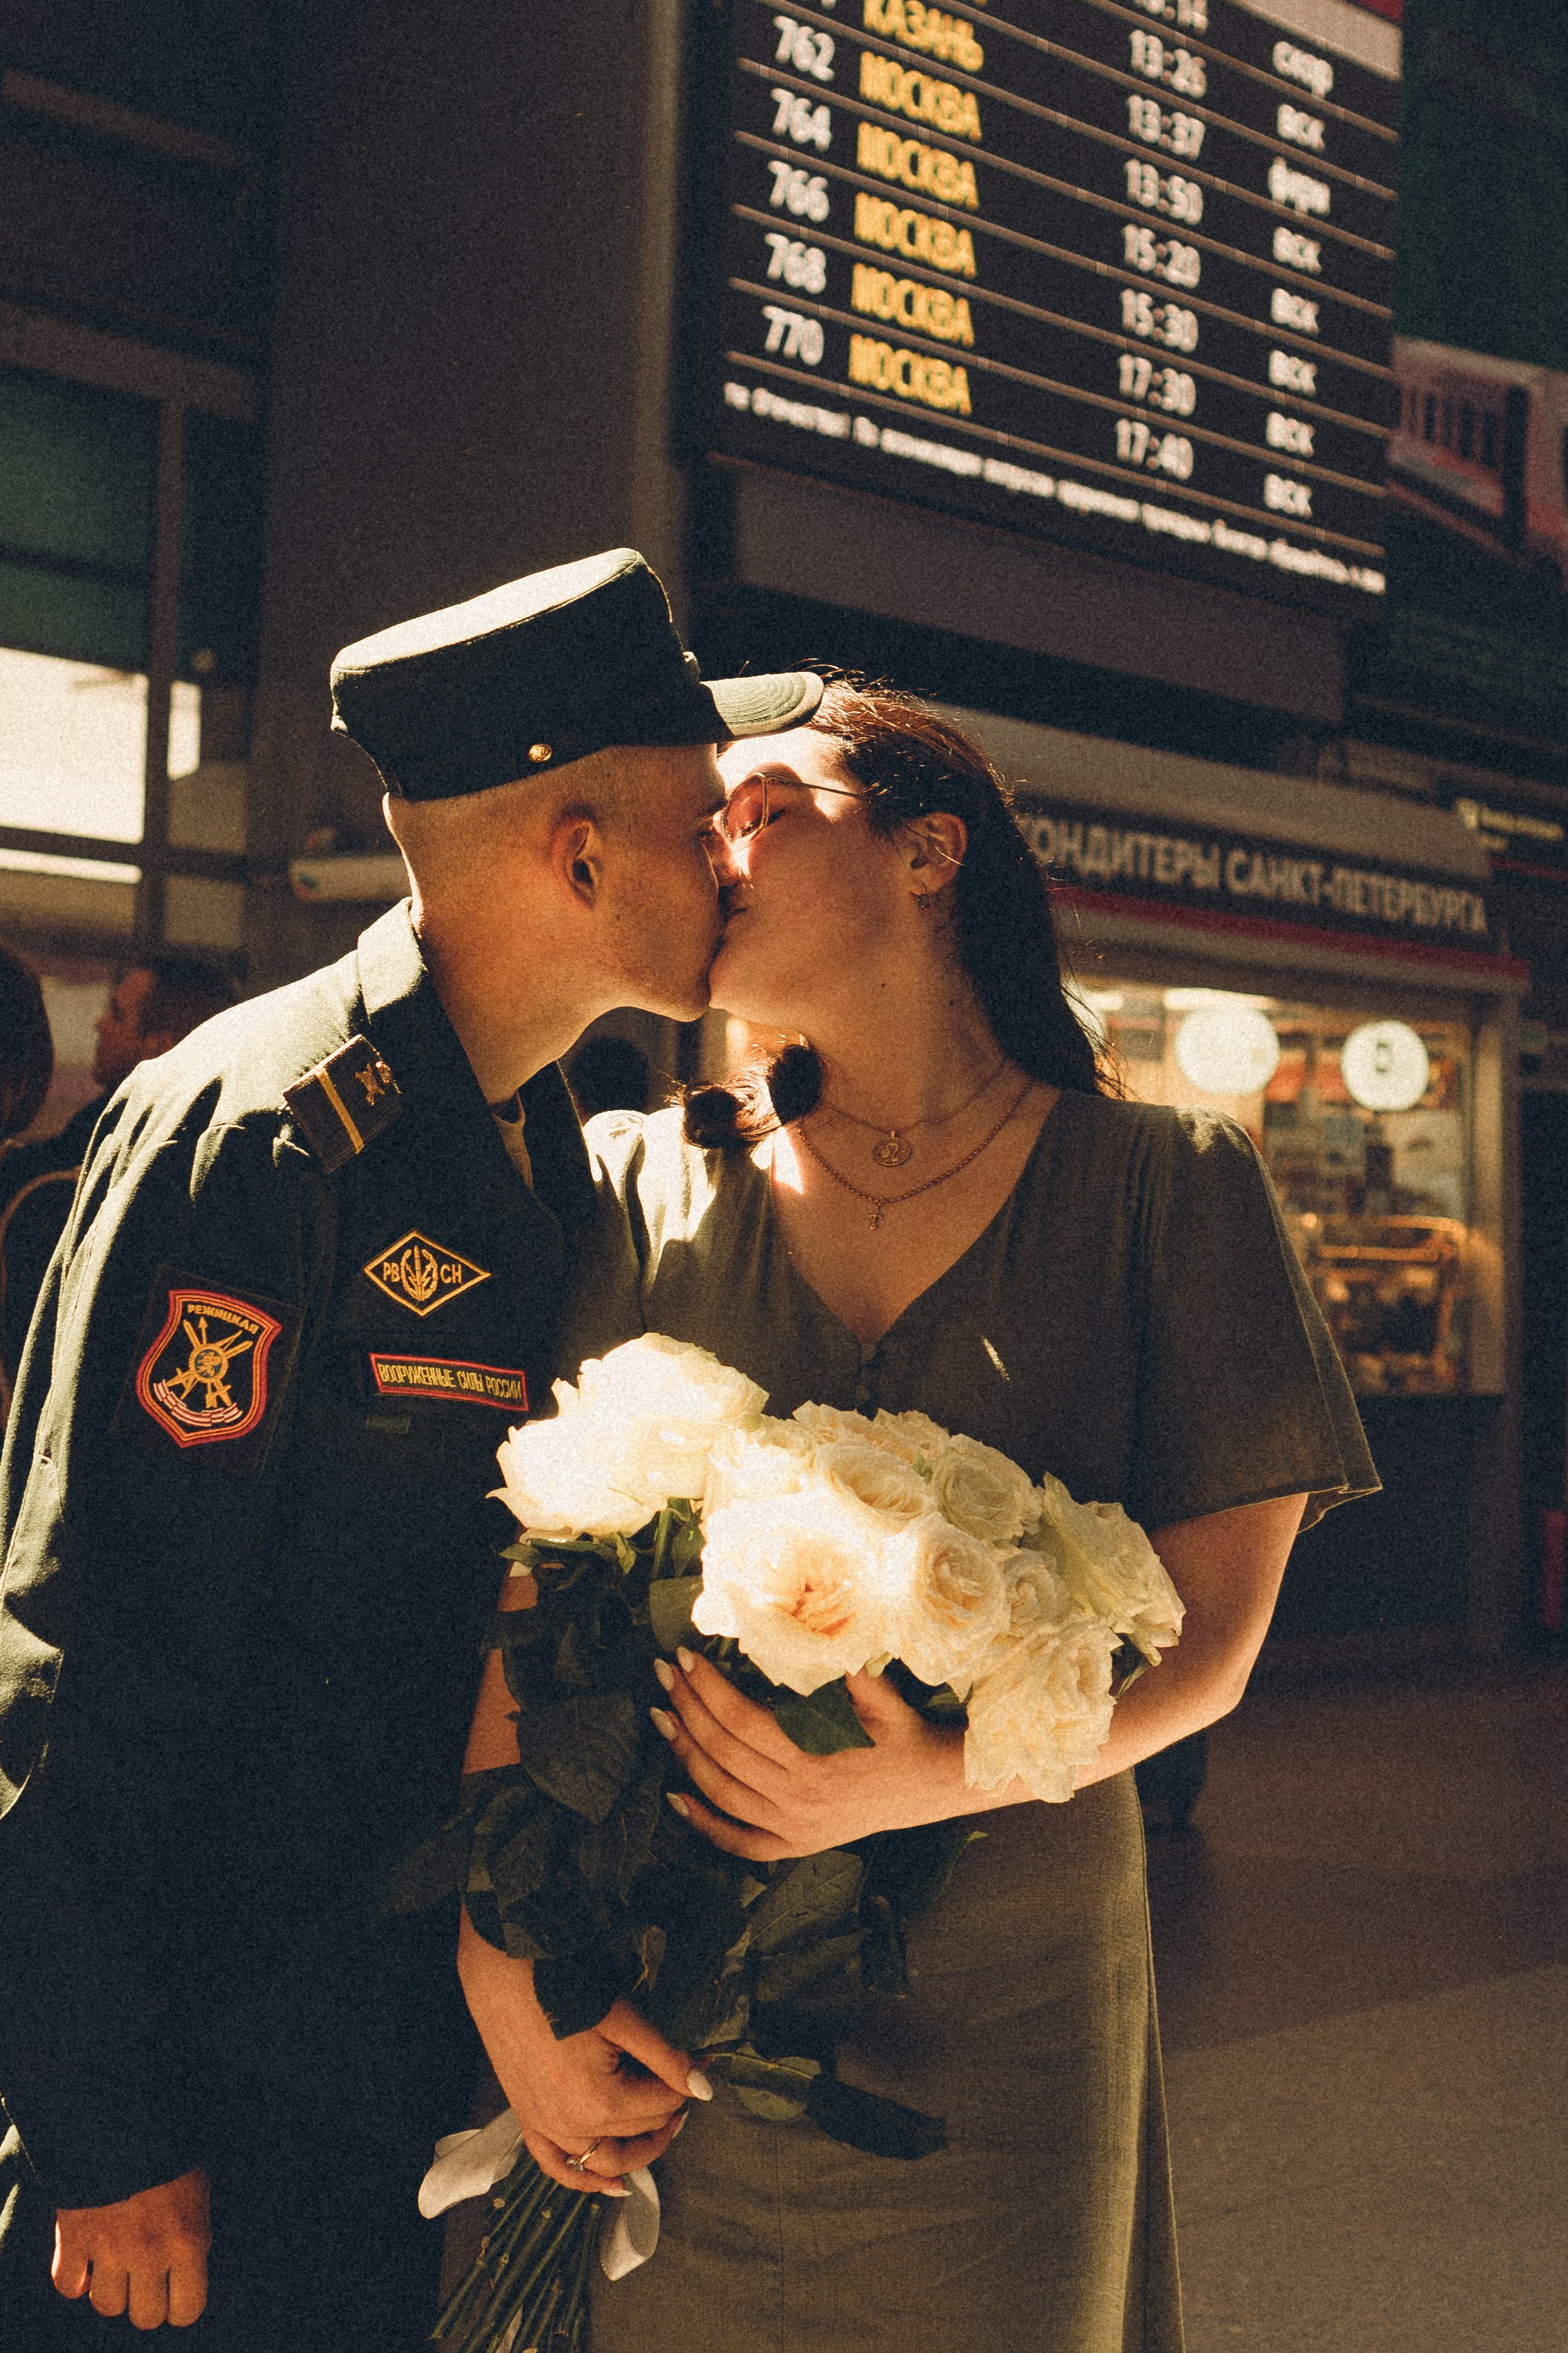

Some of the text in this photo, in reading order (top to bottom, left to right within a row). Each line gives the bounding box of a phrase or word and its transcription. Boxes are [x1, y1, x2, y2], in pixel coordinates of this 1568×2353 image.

[774, 15, 835, 81] 762
[859, 50, 982, 141] МОСКВА
[1125, 159, 1203, 224] 13:50
[863, 0, 984, 71] КАЗАНЬ
[1128, 94, 1205, 158] 13:37
[768, 160, 830, 222] 766
[854, 192, 977, 279] МОСКВА
[1120, 288, 1199, 352] 15:30
[771, 88, 833, 151] 764
[856, 121, 979, 211] МОСКВА
[1123, 224, 1201, 288] 15:20
[762, 305, 824, 366] 770
[848, 334, 972, 415] МОСКВА
[1117, 418, 1194, 480] 17:40
[764, 233, 827, 294] 768
[850, 263, 975, 347] МОСКВА
[1118, 354, 1196, 415] 17:30
[1225, 848, 1487, 934] САНКТ-ПЕТЕРБУРГА
[187, 1304, 259, 1335] РЕЖИЦКАЯ
[383, 1261, 462, 1284] РВ СН
[377, 1362, 522, 1399] ВООРУЖЕННЫЕ СИЛЫ РОССИИ
